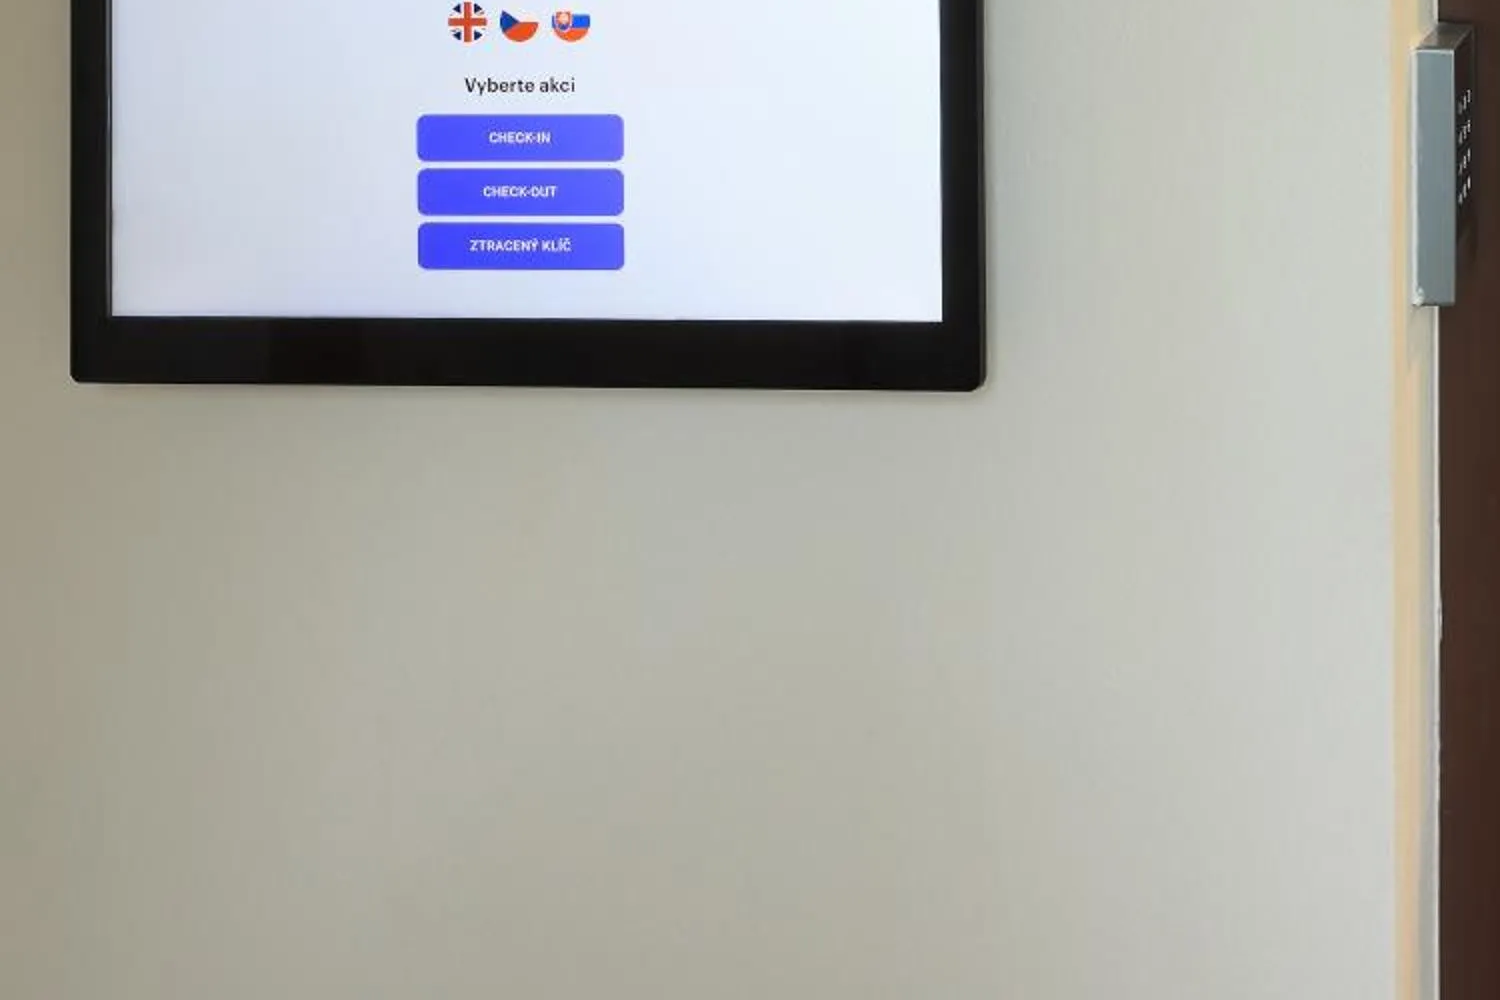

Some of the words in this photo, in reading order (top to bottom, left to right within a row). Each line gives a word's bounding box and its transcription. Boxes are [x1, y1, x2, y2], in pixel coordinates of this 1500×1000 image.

[464, 77, 535, 95] Vyberte
[539, 77, 576, 94] akci
[488, 131, 551, 144] CHECK-IN
[482, 185, 558, 198] CHECK-OUT
[469, 237, 538, 252] ZTRACENÝ
[541, 237, 572, 252] KLÍČ
